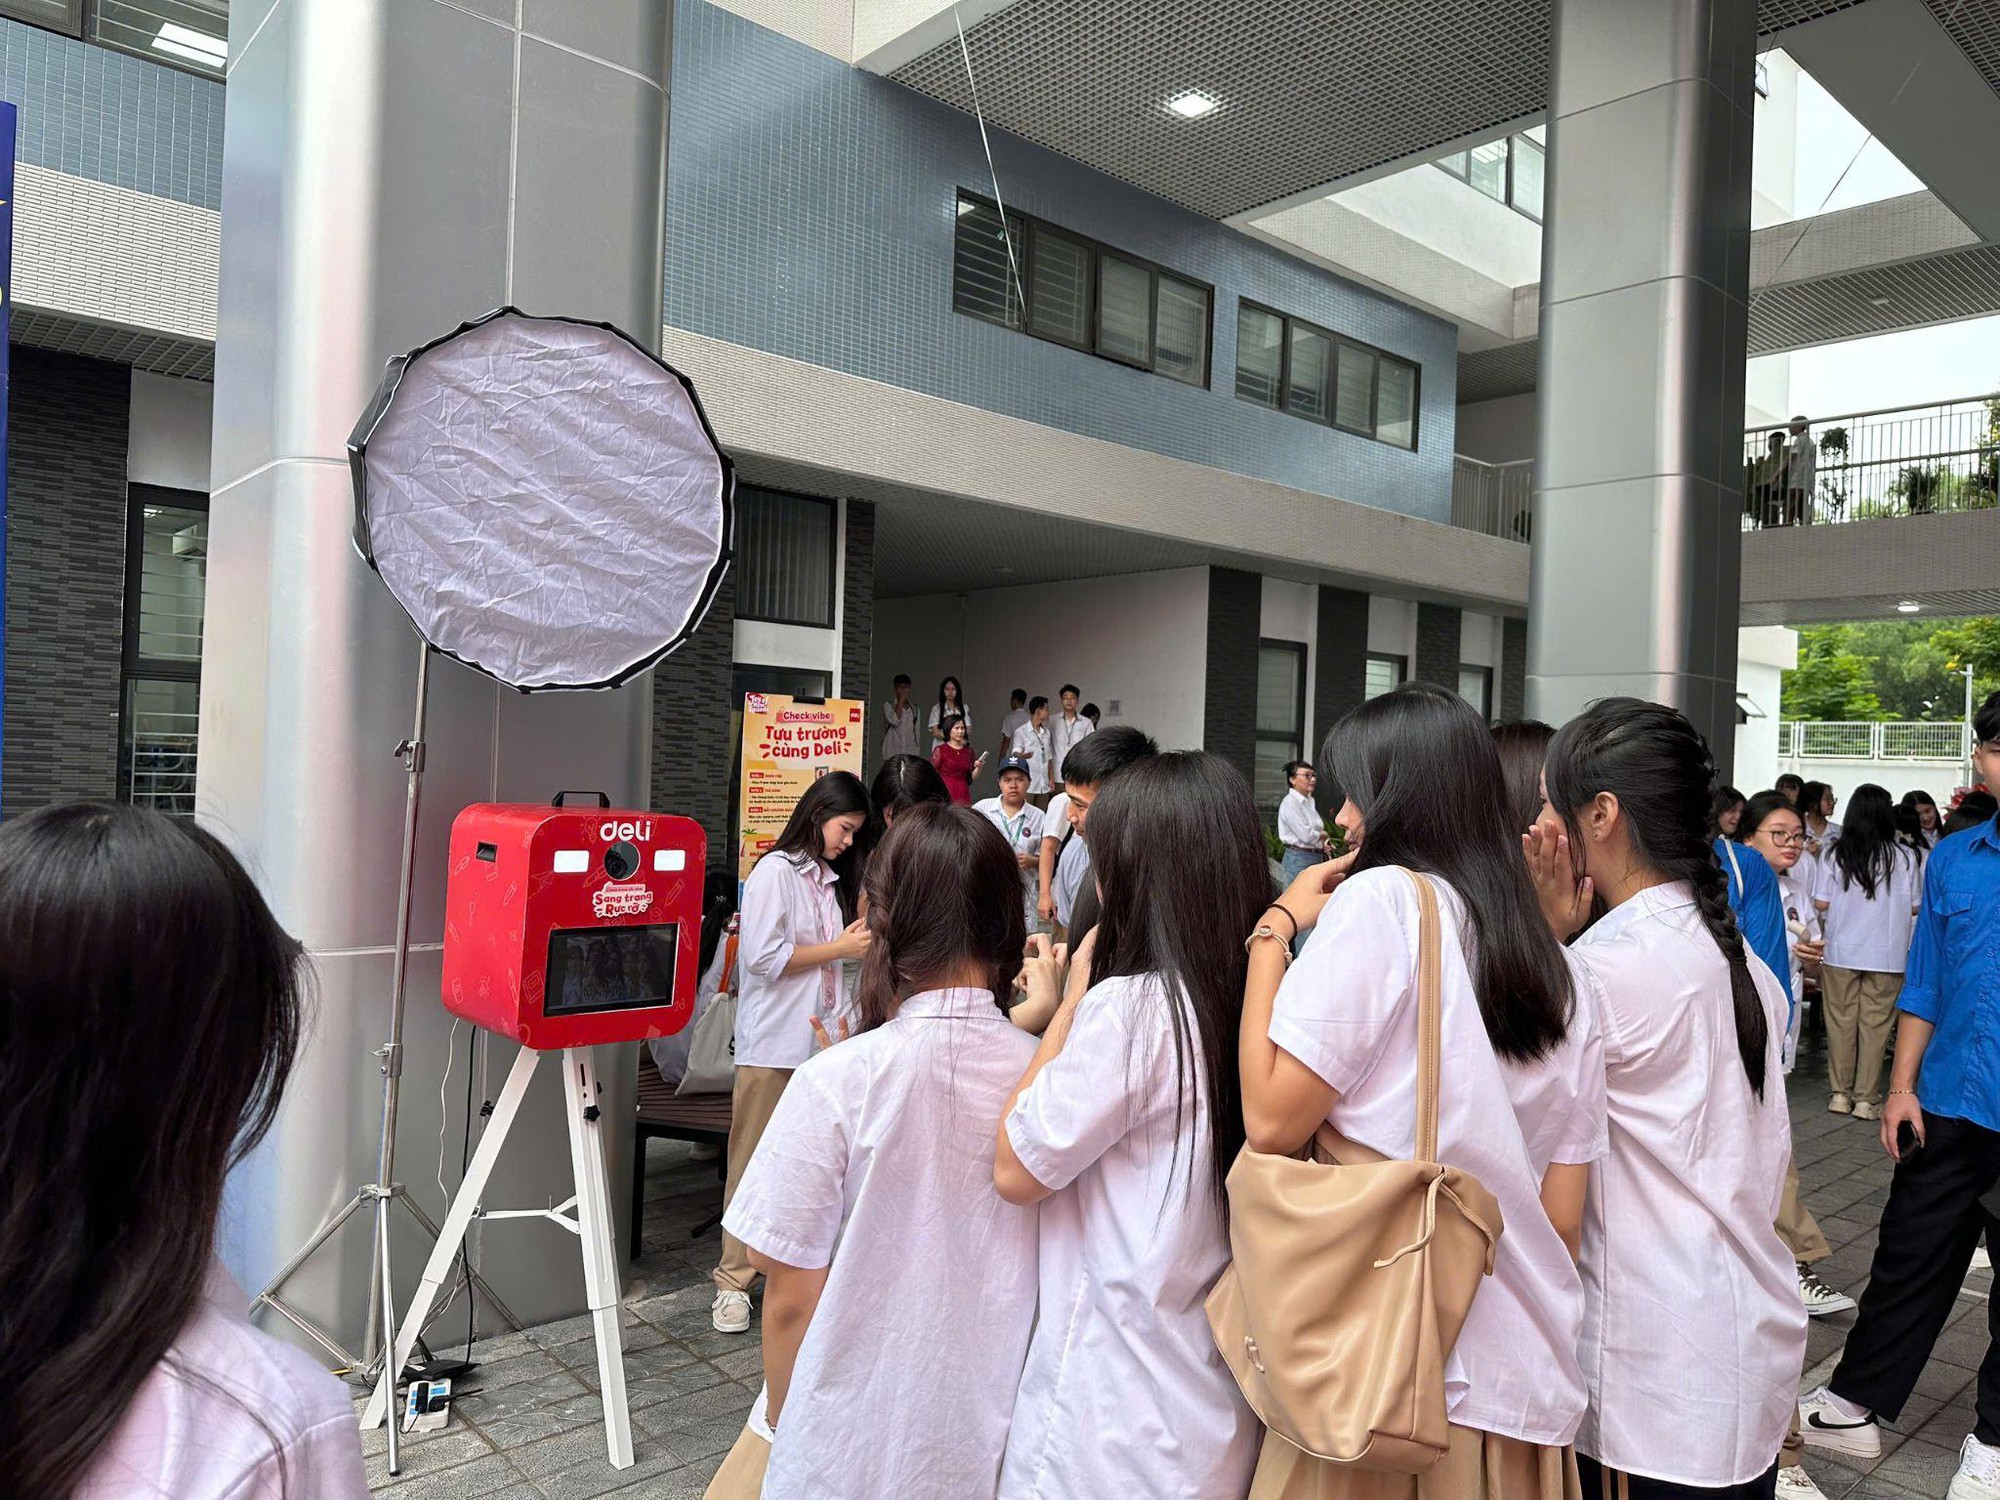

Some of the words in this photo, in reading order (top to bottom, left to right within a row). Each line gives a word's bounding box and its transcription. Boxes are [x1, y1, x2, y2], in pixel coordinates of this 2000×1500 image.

[783, 711, 810, 720] Check
[812, 711, 830, 720] vibe
[765, 725, 792, 744] Tựu
[797, 725, 847, 742] trường
[772, 742, 810, 760] cùng
[814, 741, 842, 757] Deli
[600, 820, 651, 841] deli
[595, 893, 622, 905] Sang
[624, 893, 652, 903] trang
[605, 903, 626, 915] Rực
[627, 902, 641, 913] rỡ
